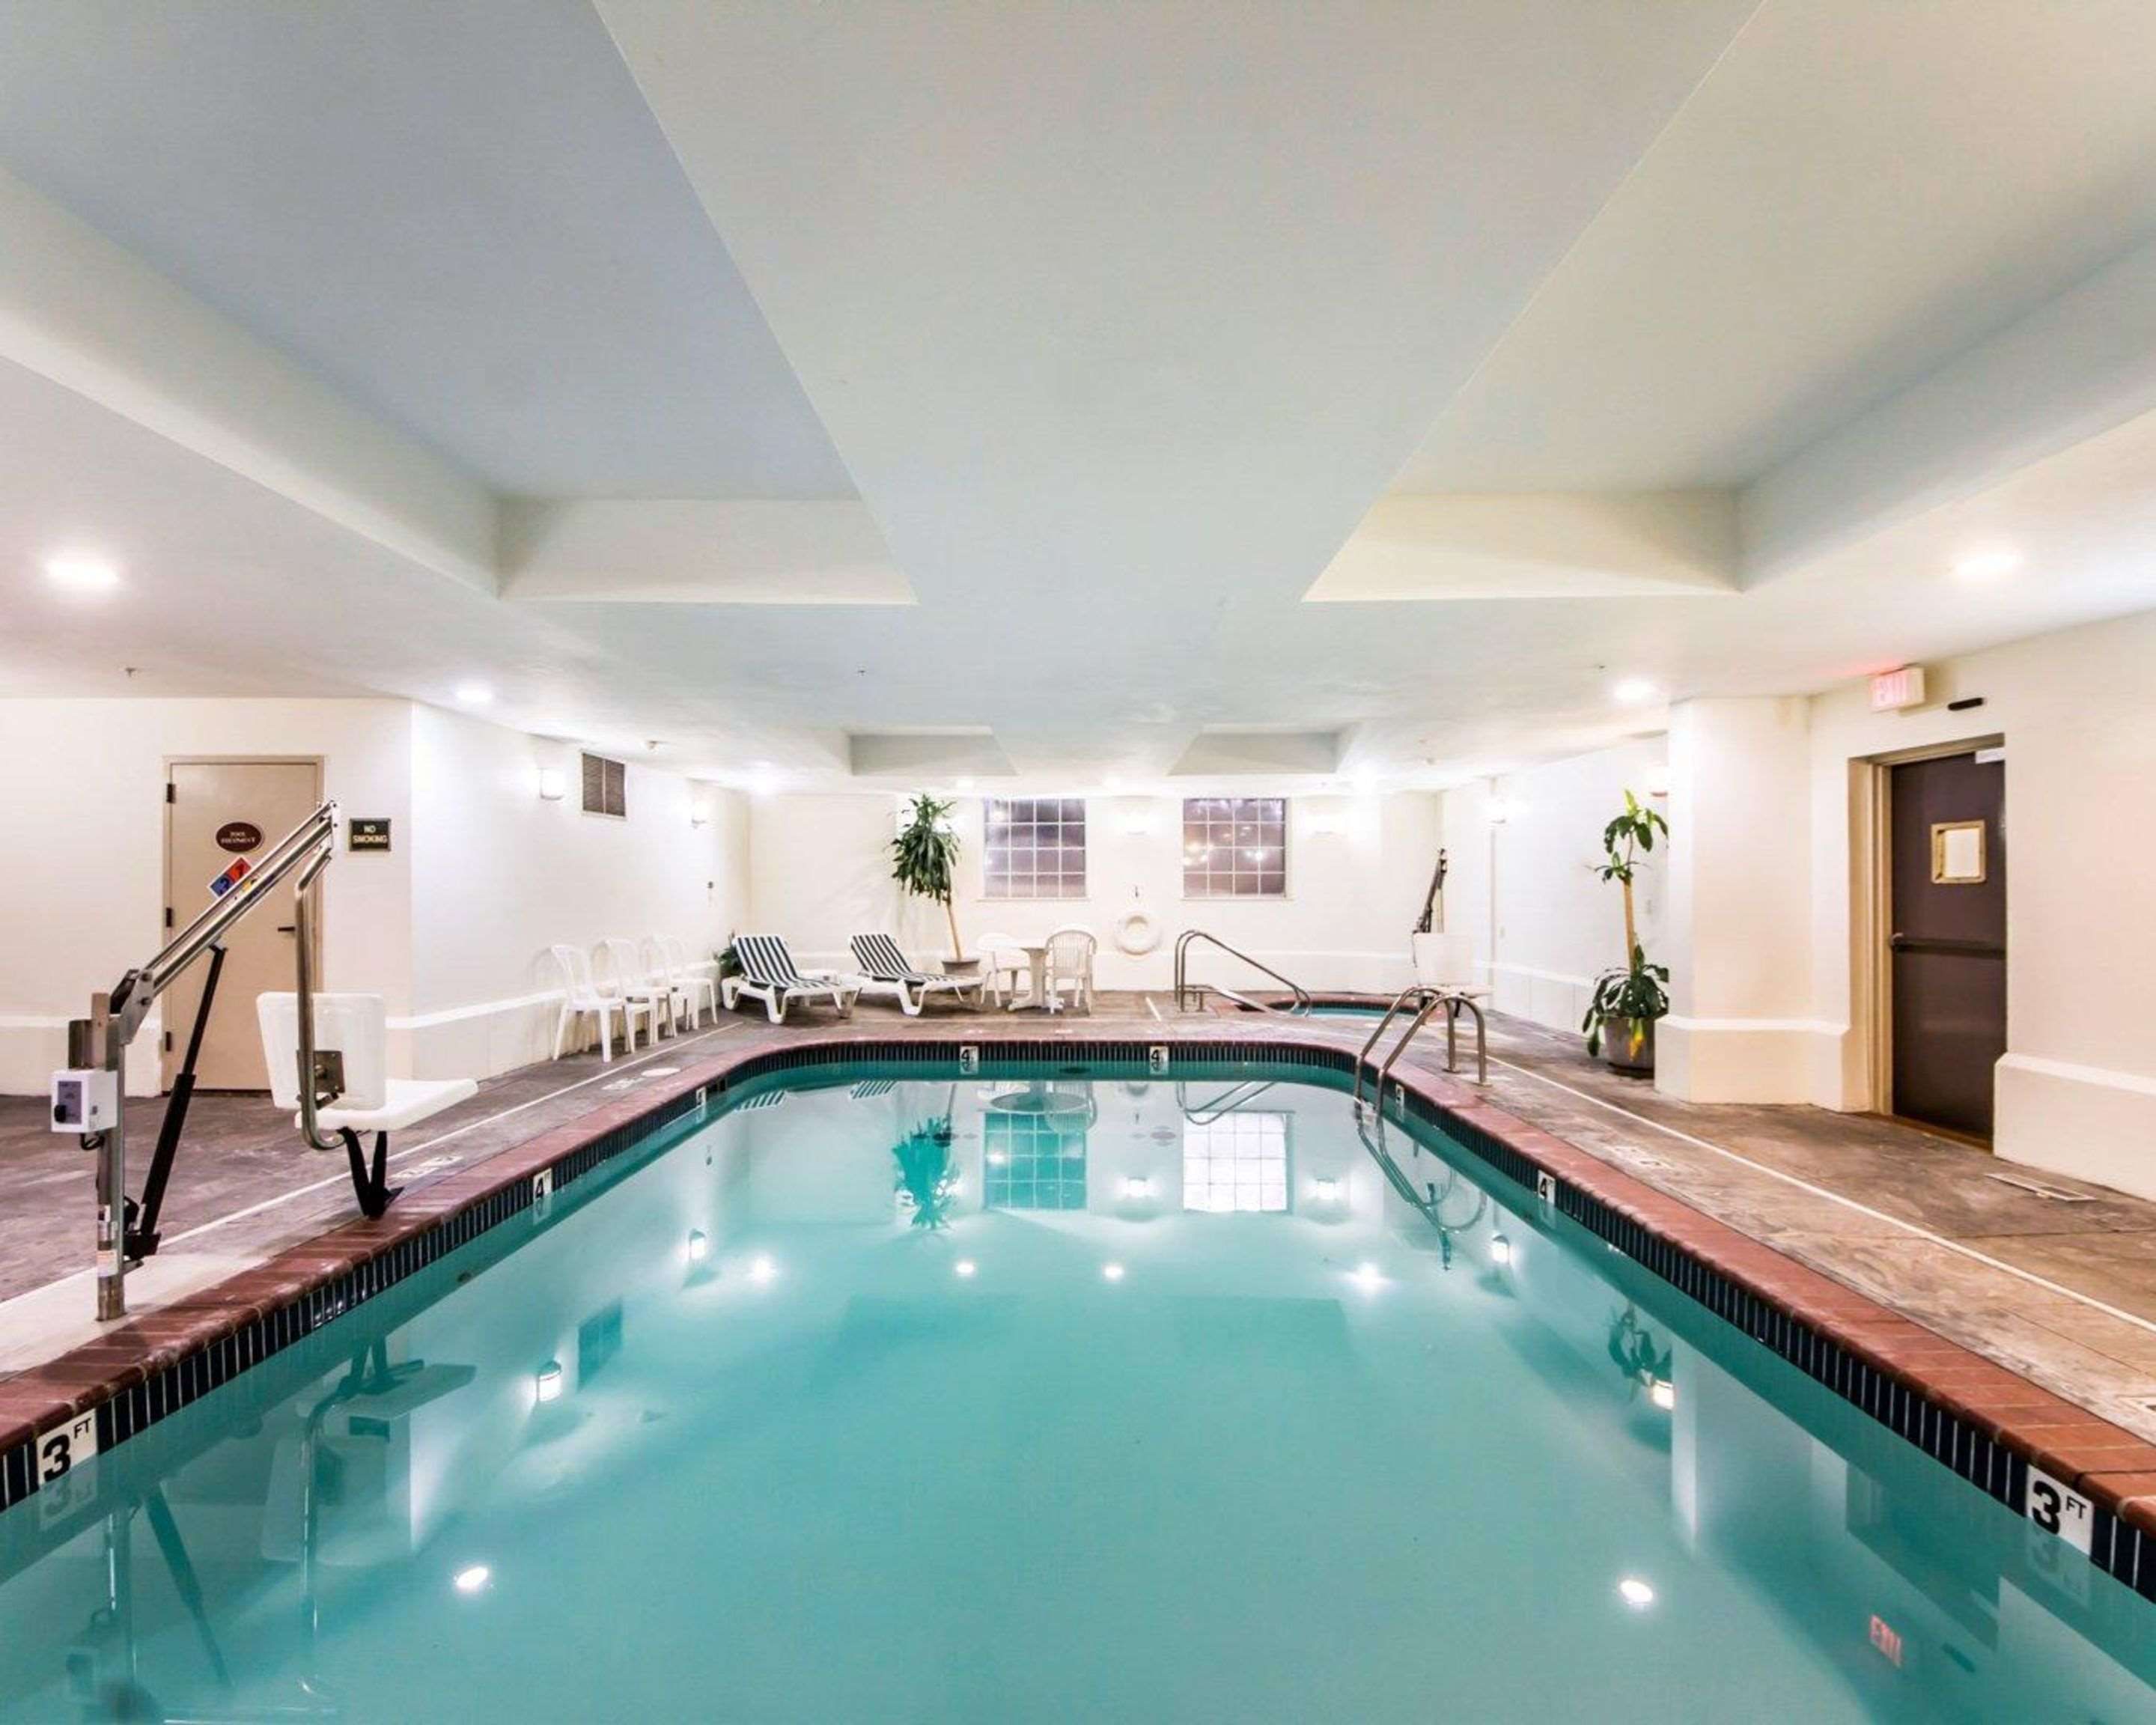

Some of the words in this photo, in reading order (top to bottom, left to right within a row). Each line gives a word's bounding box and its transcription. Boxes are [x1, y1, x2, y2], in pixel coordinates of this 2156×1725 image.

[363, 825, 377, 833] NO
[353, 835, 388, 844] SMOKING
[961, 1049, 969, 1061] 4
[1151, 1049, 1160, 1062] 4
[535, 1178, 544, 1198] 4
[1540, 1178, 1548, 1198] 4
[43, 1435, 71, 1482] 3
[73, 1417, 91, 1439] FT
[2032, 1480, 2061, 1535] 3
[2066, 1496, 2086, 1519] FT
